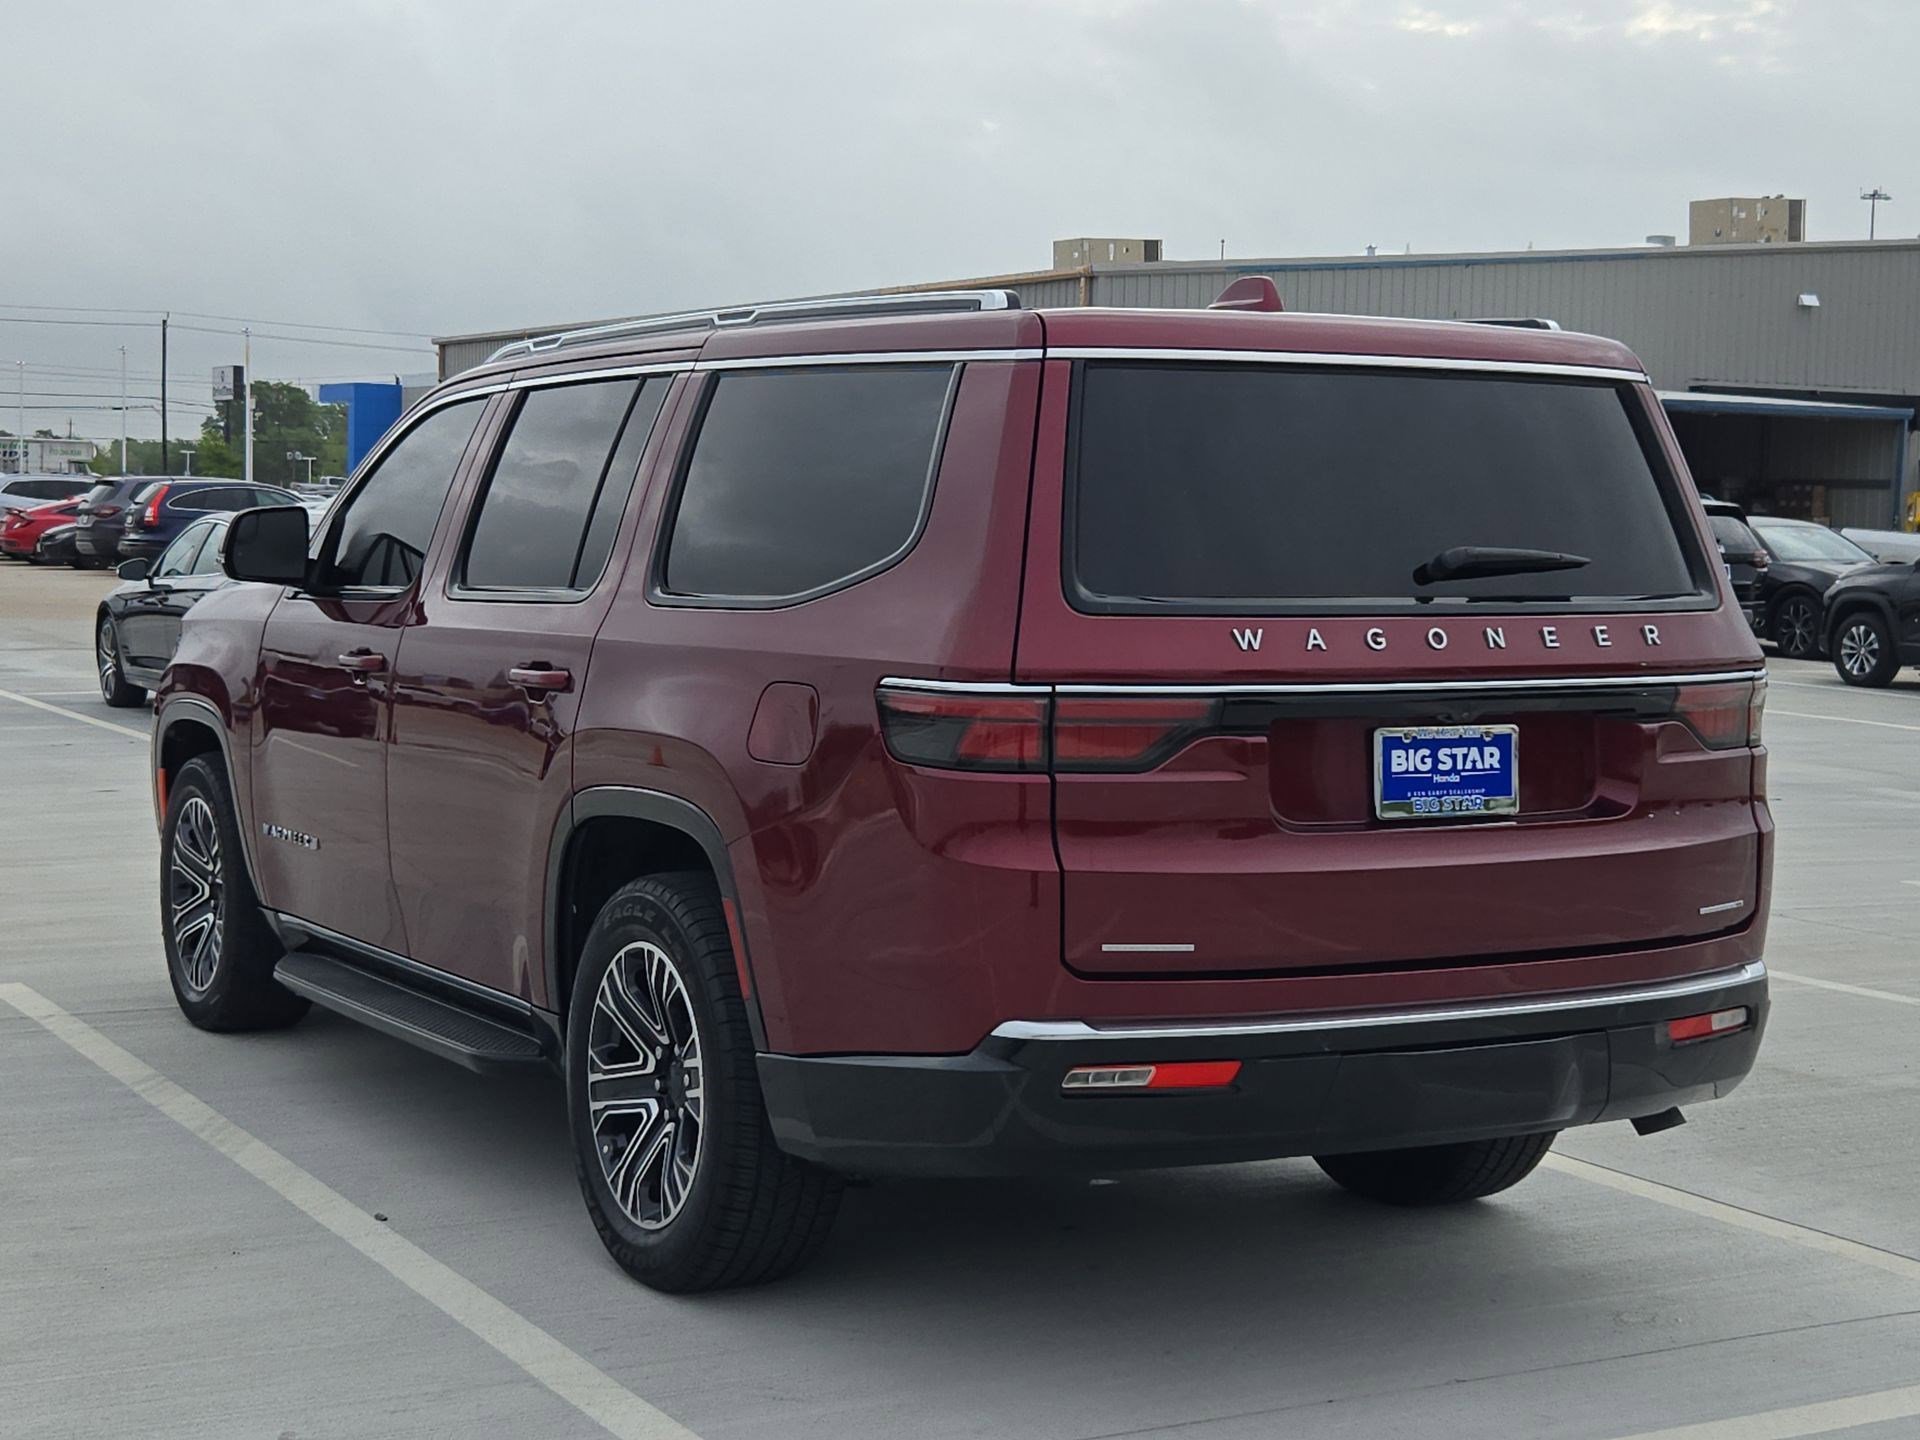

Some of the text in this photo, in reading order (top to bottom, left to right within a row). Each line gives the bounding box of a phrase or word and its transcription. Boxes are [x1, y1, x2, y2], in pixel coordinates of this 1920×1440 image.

[1232, 625, 1662, 651] WAGONEER
[1391, 746, 1501, 773] BIG STAR
[1433, 773, 1460, 783] Honda
[1413, 795, 1484, 812] BIG STAR
